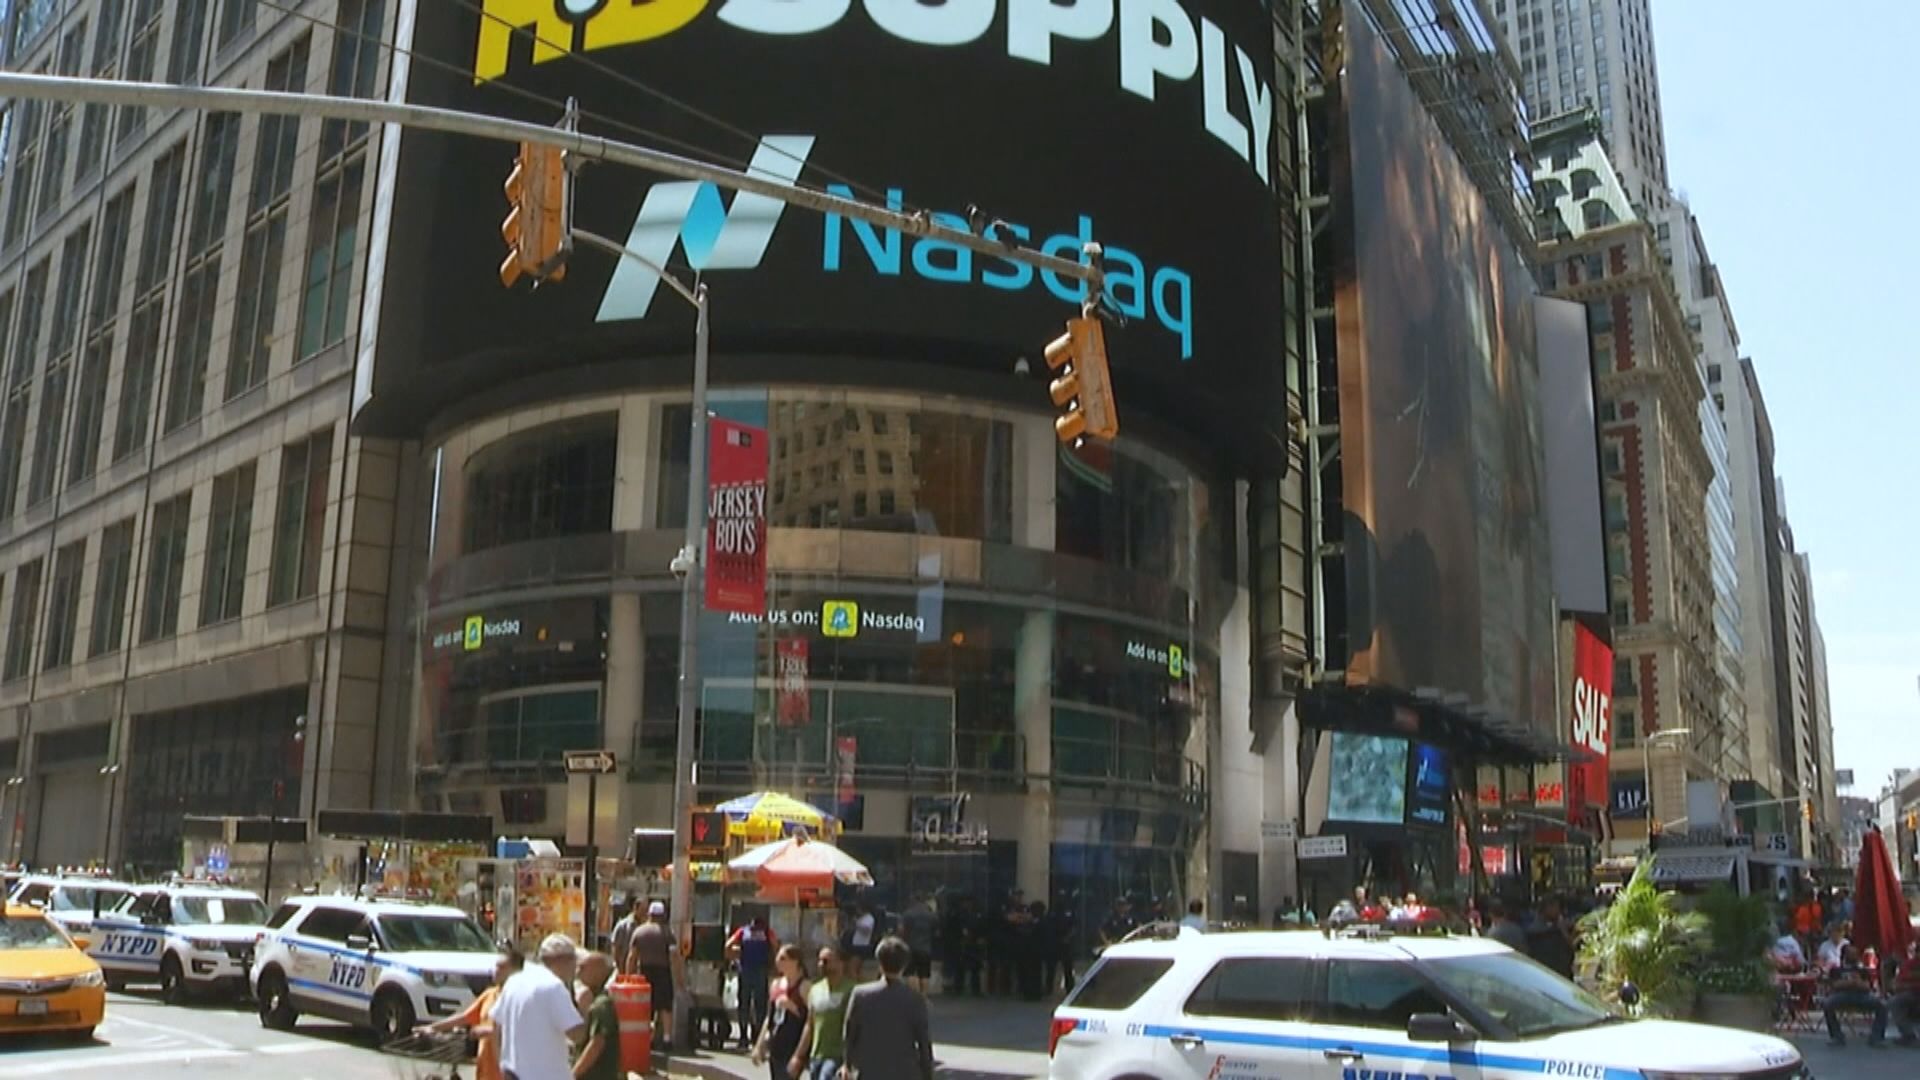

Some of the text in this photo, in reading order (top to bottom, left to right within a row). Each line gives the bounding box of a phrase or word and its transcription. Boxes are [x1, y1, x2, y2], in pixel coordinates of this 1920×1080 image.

[822, 183, 1192, 360] Nasdaq
[709, 486, 764, 520] JERSEY
[716, 518, 757, 554] BOYS
[484, 619, 520, 636] Nasdaq
[767, 610, 787, 624] us
[792, 610, 819, 625] on:
[862, 612, 925, 633] Nasdaq
[1126, 641, 1145, 658] Add
[1574, 677, 1608, 756] SALE
[1618, 789, 1641, 809] GAP
[100, 934, 157, 956] NYPD
[329, 961, 366, 988] NYPD
[1546, 1060, 1604, 1080] POLICE
